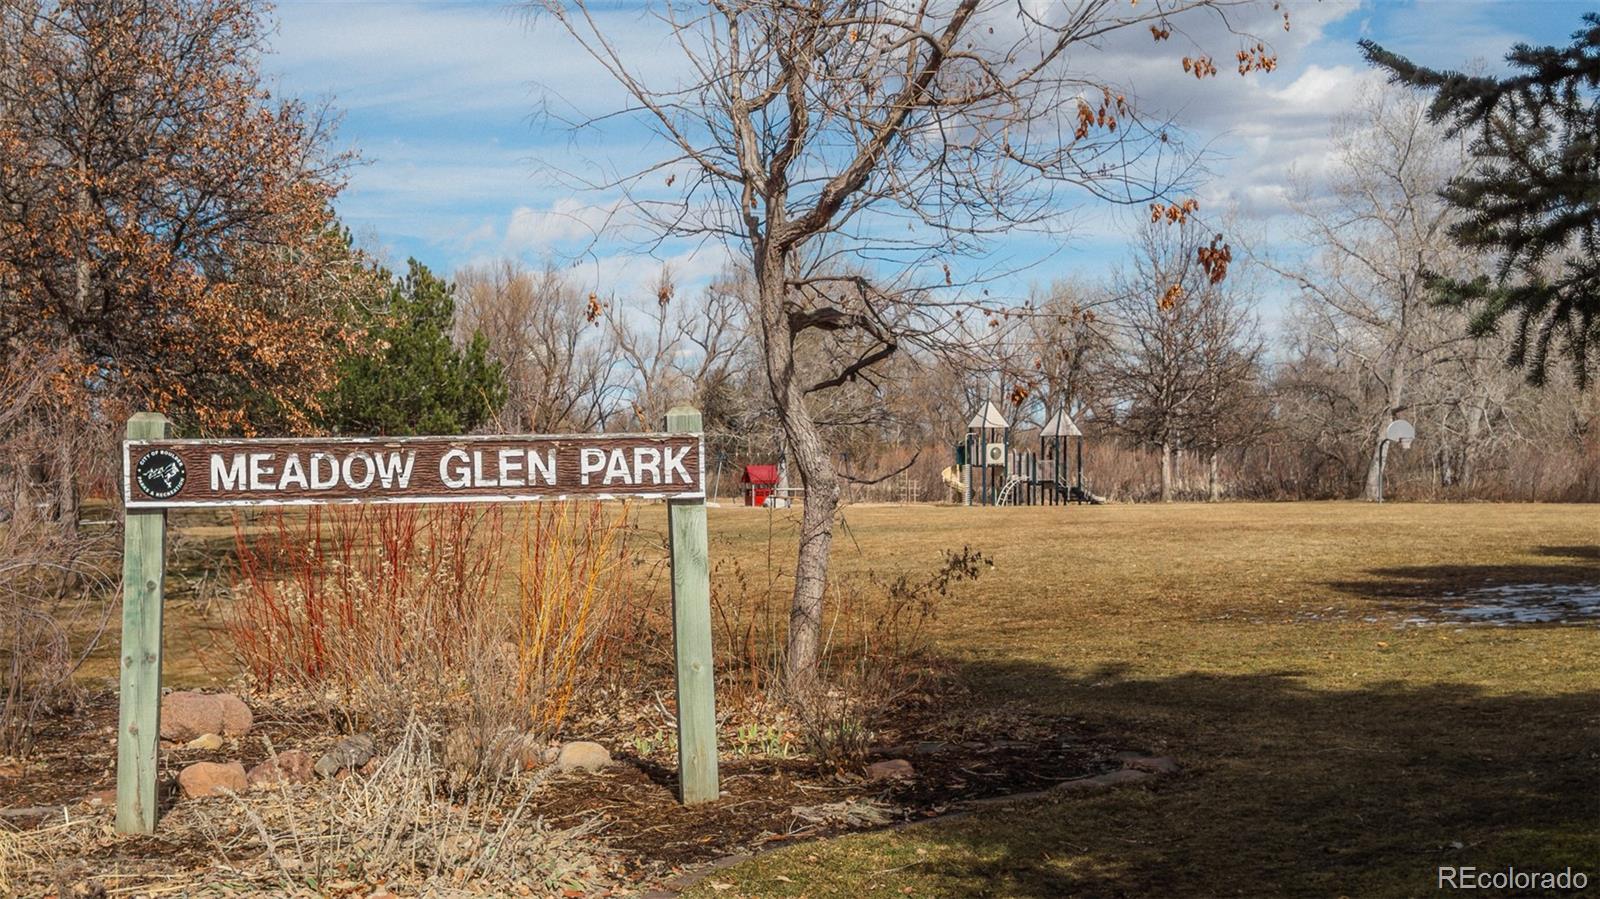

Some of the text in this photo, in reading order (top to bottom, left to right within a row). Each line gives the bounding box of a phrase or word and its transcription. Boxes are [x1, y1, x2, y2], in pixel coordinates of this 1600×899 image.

[139, 454, 151, 466] CITY
[160, 450, 183, 467] BOULDER
[210, 446, 693, 490] MEADOW GLEN PARK
[137, 476, 150, 492] PARKS
[155, 477, 185, 497] RECREATION
